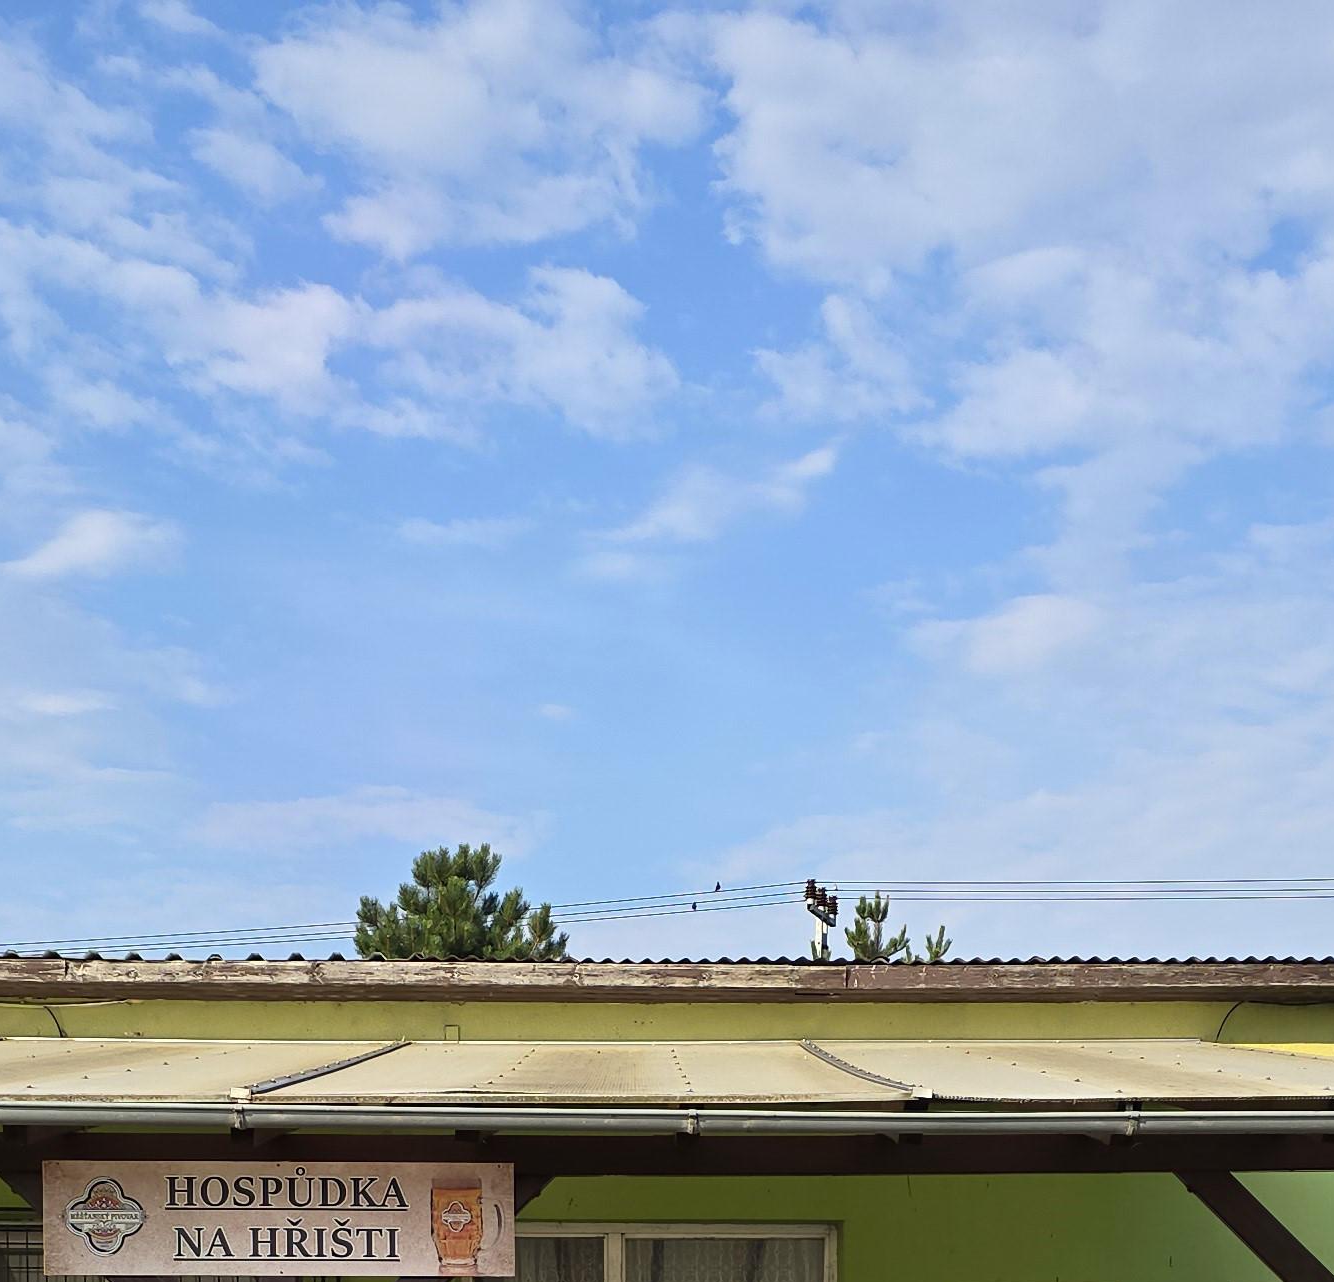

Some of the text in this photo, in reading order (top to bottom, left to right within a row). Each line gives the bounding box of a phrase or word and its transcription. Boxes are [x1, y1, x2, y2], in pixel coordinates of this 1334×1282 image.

[165, 1167, 410, 1208] HOSPŮDKA
[174, 1217, 401, 1259] NA HŘIŠTI
